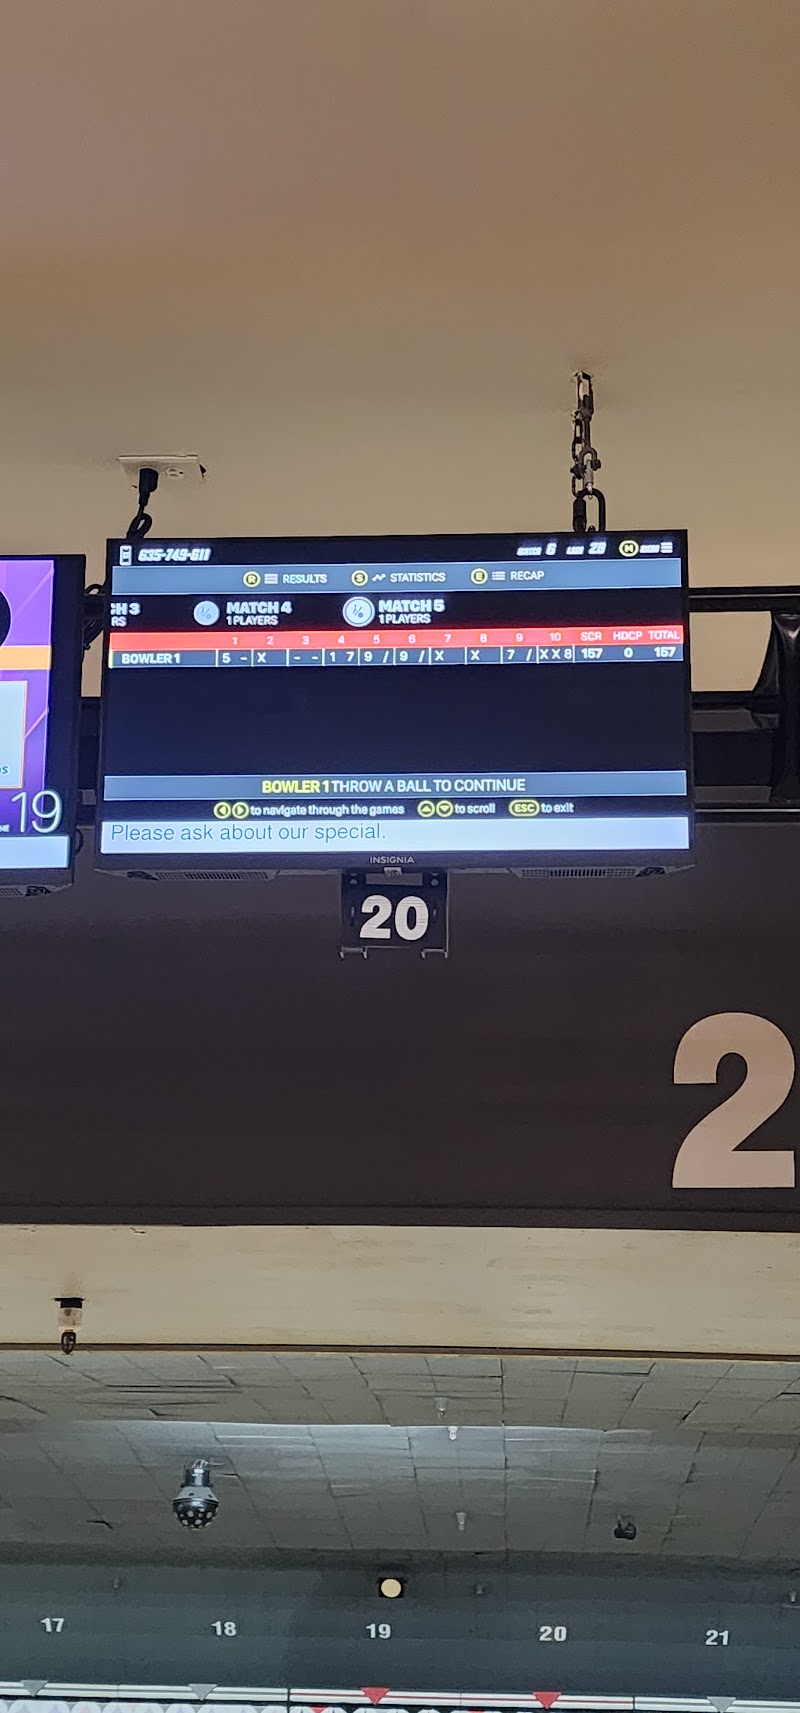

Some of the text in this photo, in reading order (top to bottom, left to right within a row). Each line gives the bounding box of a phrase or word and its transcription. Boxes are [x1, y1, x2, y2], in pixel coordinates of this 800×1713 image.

[546, 542, 556, 555] 6
[282, 574, 328, 584] RESULTS
[390, 572, 446, 582] STATISTICS
[510, 571, 544, 580] RECAP
[128, 602, 141, 616] 3
[226, 601, 292, 614] MATCH 4
[378, 599, 446, 613] MATCH 5
[226, 616, 278, 626] 1 PLAYERS
[379, 614, 432, 624] 1 PLAYERS
[232, 630, 680, 645] 1 2 3 4 5 6 7 8 9 10 SCR HDCP TOTAL
[122, 653, 171, 664] BOWLER
[174, 653, 180, 664] 1
[222, 653, 230, 664] 5
[257, 652, 267, 662] X
[329, 652, 336, 662] 1
[346, 652, 354, 662] 7
[364, 651, 372, 662] 9
[400, 650, 408, 662] 9
[434, 650, 444, 661] X
[470, 650, 480, 660] X
[506, 650, 516, 660] 7
[540, 649, 548, 660] X
[552, 649, 560, 660] X
[564, 649, 572, 660] 8
[581, 648, 603, 659] 157
[624, 648, 634, 658] 0
[654, 646, 676, 658] 157
[262, 778, 526, 794] BOWLER 1 THROW A BALL TO CONTINUE
[12, 790, 62, 834] 19
[251, 804, 405, 818] to navigate through the games
[454, 802, 496, 814] to scroll
[541, 802, 552, 813] to
[554, 802, 574, 813] exit
[112, 823, 386, 843] Please ask about our special.
[370, 856, 414, 864] INSIGNIA
[359, 894, 429, 941] 20
[672, 1012, 796, 1188] 2
[40, 1617, 730, 1646] 17 18 19 20 21
